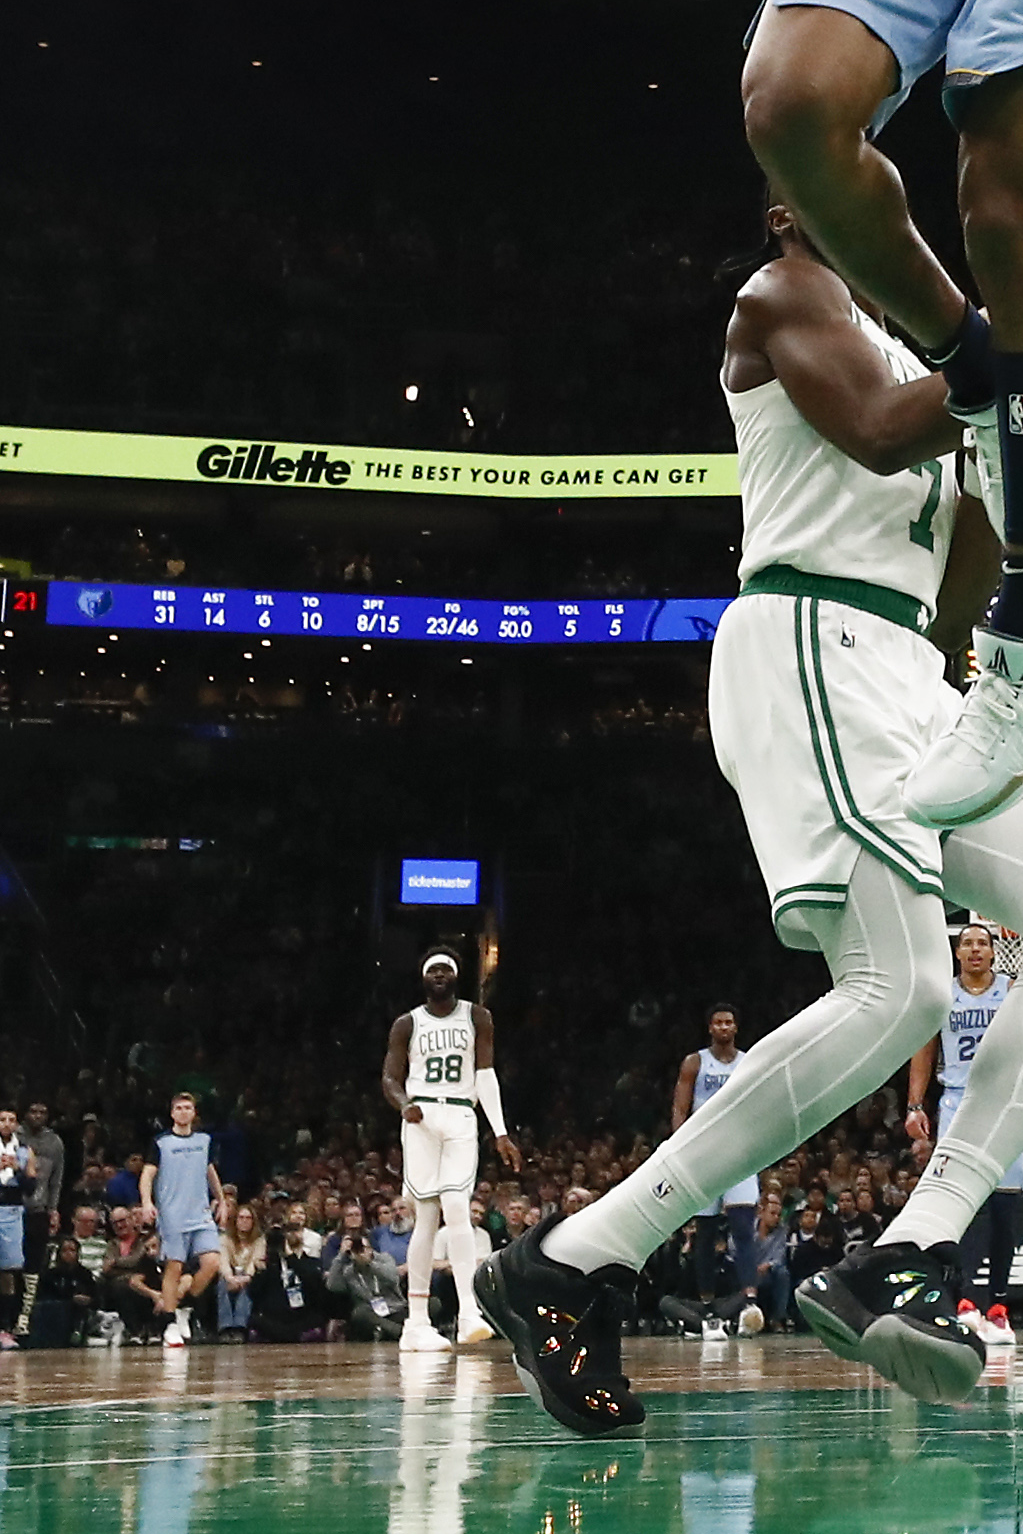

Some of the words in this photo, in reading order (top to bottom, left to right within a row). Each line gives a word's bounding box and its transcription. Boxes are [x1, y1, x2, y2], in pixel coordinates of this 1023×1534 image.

[196, 444, 351, 485] Gillette
[364, 462, 403, 478] THE
[412, 464, 461, 482] BEST
[469, 467, 530, 485] YOUR
[540, 469, 603, 485] GAME
[613, 468, 659, 485] CAN
[668, 468, 708, 484] GET
[909, 459, 943, 554] 7
[13, 591, 38, 611] 21
[153, 590, 176, 602] REB
[202, 592, 226, 604] AST
[254, 594, 275, 606] STL
[302, 596, 319, 608] TO
[363, 599, 385, 612] 3PT
[444, 602, 461, 614] FG
[503, 605, 530, 616] FG%
[558, 604, 580, 616] TOL
[604, 603, 624, 615] FLS
[154, 605, 176, 624] 31
[203, 608, 226, 626] 14
[258, 609, 271, 628] 6
[301, 612, 323, 630] 10
[356, 614, 400, 634] 8/15
[426, 617, 479, 636] 23/46
[498, 620, 532, 638] 50.0
[564, 619, 577, 637] 5
[609, 619, 622, 637] 5
[408, 875, 472, 889] ticketmaster
[419, 1028, 468, 1056] CELTICS
[959, 1034, 983, 1061] 2
[425, 1054, 463, 1083] 88
